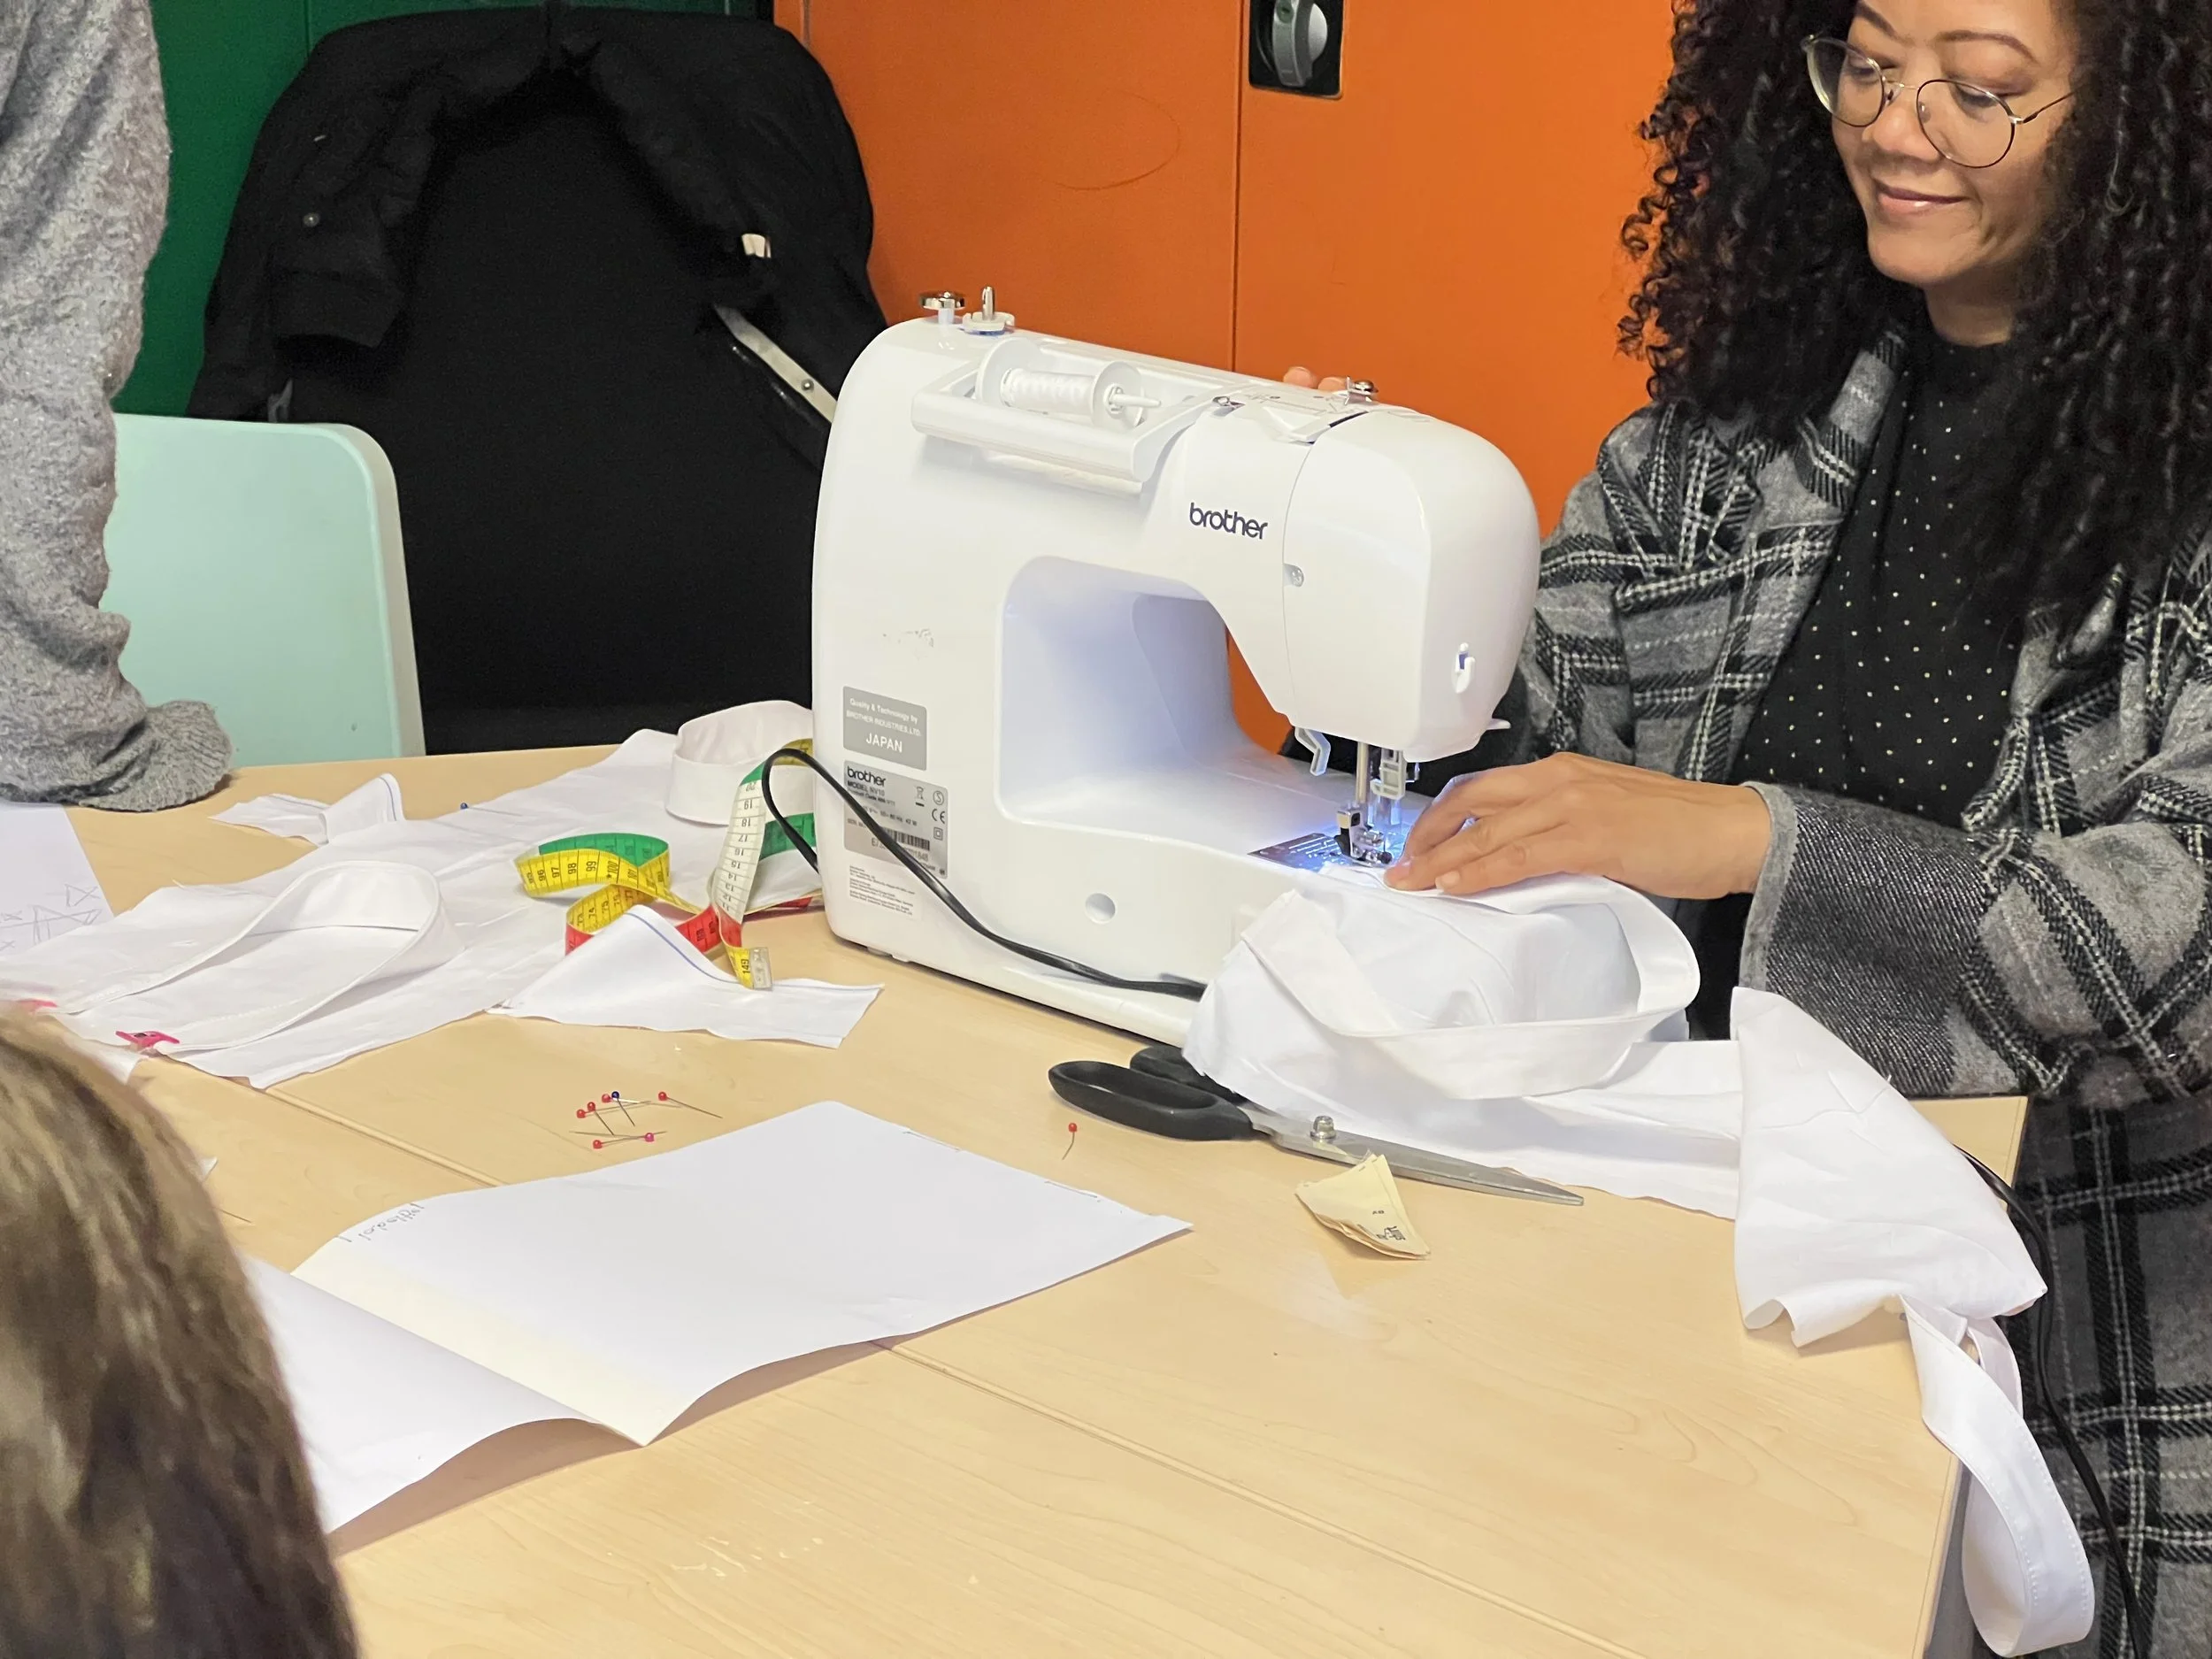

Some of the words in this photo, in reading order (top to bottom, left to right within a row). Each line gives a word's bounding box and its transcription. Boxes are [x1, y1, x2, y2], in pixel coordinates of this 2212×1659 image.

[1189, 502, 1268, 540] brother
[846, 710, 874, 724] BROTHER
[849, 697, 870, 711] Quality
[877, 704, 910, 722] Technology
[910, 715, 918, 725] by
[866, 733, 902, 753] JAPAN
[847, 765, 886, 787] brother
[847, 780, 868, 792] MODEL
[743, 799, 753, 810] 19
[741, 818, 751, 827] 18
[734, 848, 744, 856] 16
[551, 866, 560, 878] 97
[568, 862, 577, 874] 98
[586, 861, 596, 872] 99
[607, 860, 619, 873] 100
[537, 869, 546, 881] 96
[728, 872, 737, 881] 14
[726, 883, 734, 892] 13
[588, 907, 595, 918] 74
[741, 958, 750, 974] 149
